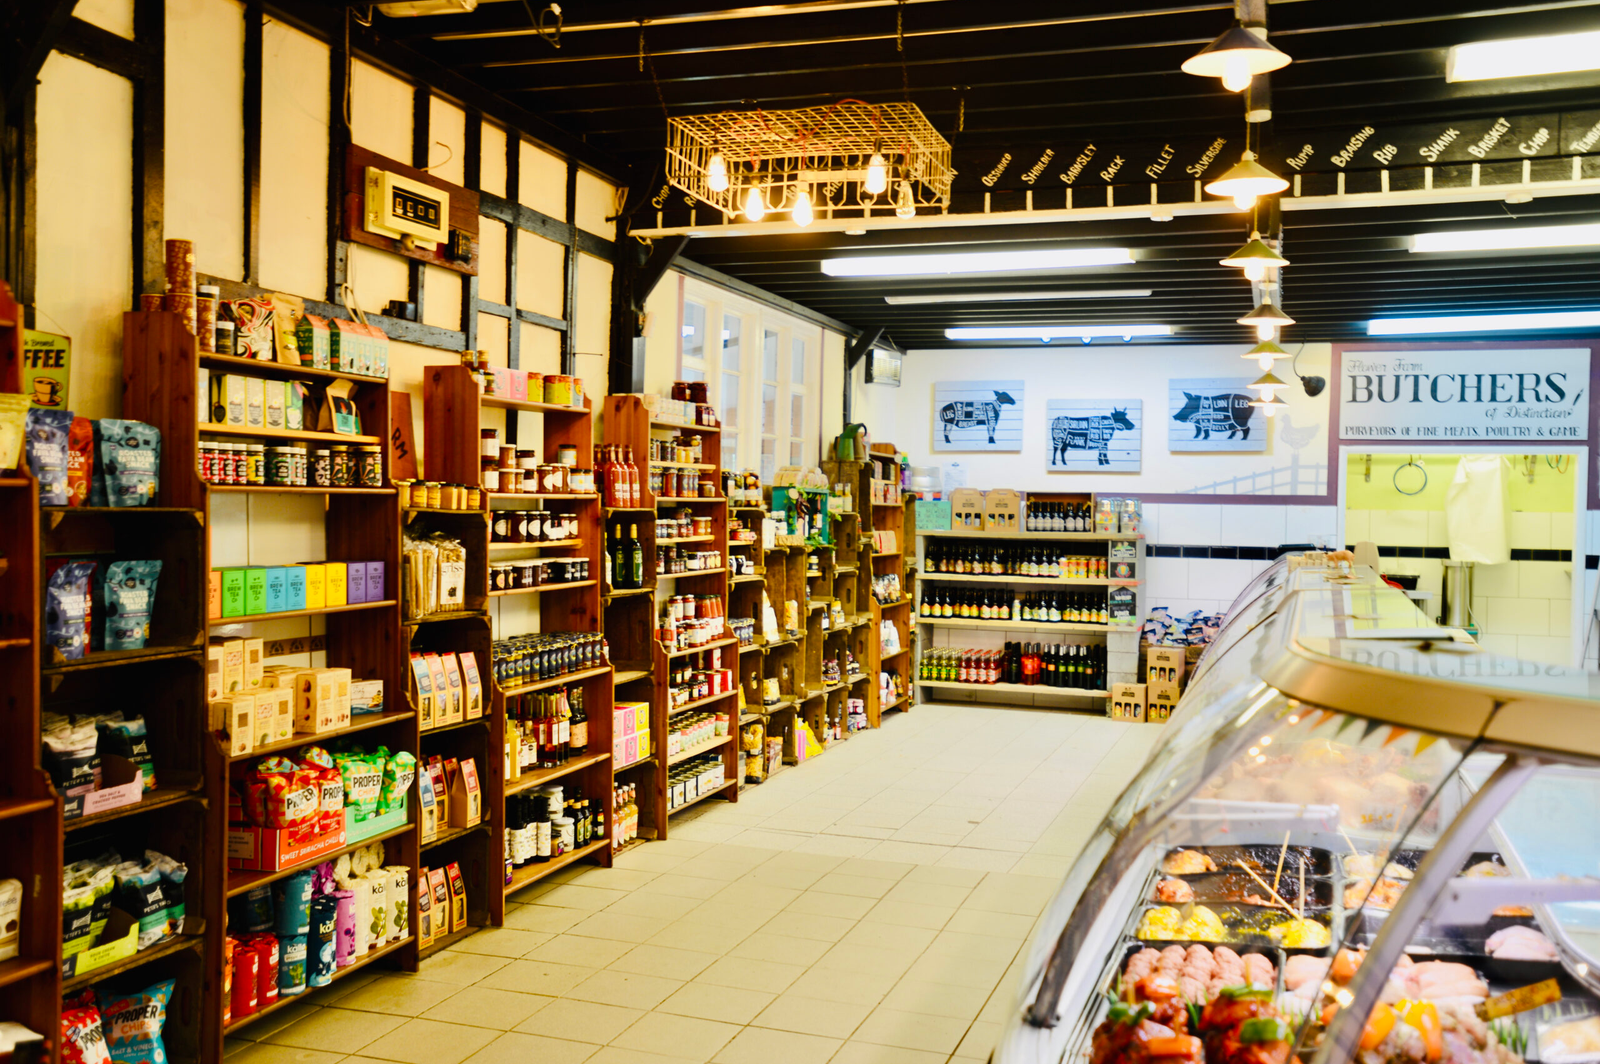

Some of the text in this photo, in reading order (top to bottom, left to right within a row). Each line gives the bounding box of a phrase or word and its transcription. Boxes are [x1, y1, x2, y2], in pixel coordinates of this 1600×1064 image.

[1330, 126, 1375, 168] BRAISING
[1419, 127, 1460, 163] SHANK
[1467, 117, 1511, 159] BRISKET
[1518, 127, 1550, 155] CHOP
[1569, 120, 1600, 153] TENDE
[1021, 148, 1055, 185] SHOULDER
[1059, 143, 1097, 185] BARNSLEY
[1100, 154, 1126, 182] RACK
[1145, 143, 1175, 179] FILLET
[1186, 137, 1227, 178] SILVERSIDE
[1286, 143, 1315, 171] RUMP
[1372, 143, 1398, 165] RIB
[651, 185, 671, 209] CHOP
[24, 349, 66, 369] FFEE
[1345, 372, 1567, 404] BUTCHERS
[943, 409, 955, 420] LEG
[1234, 399, 1249, 409] LEG
[1345, 426, 1397, 436] PURVEYORS
[1401, 427, 1412, 436] OF
[1417, 427, 1440, 437] FINE
[1485, 427, 1532, 437] POULTRY
[1536, 427, 1545, 437] &
[1549, 427, 1580, 437] GAME
[353, 775, 381, 788] PROPER
[281, 835, 339, 863] SWEET SRIRACHA CHILLI
[115, 1004, 158, 1024] PROPER
[120, 1020, 152, 1035] CHIPS
